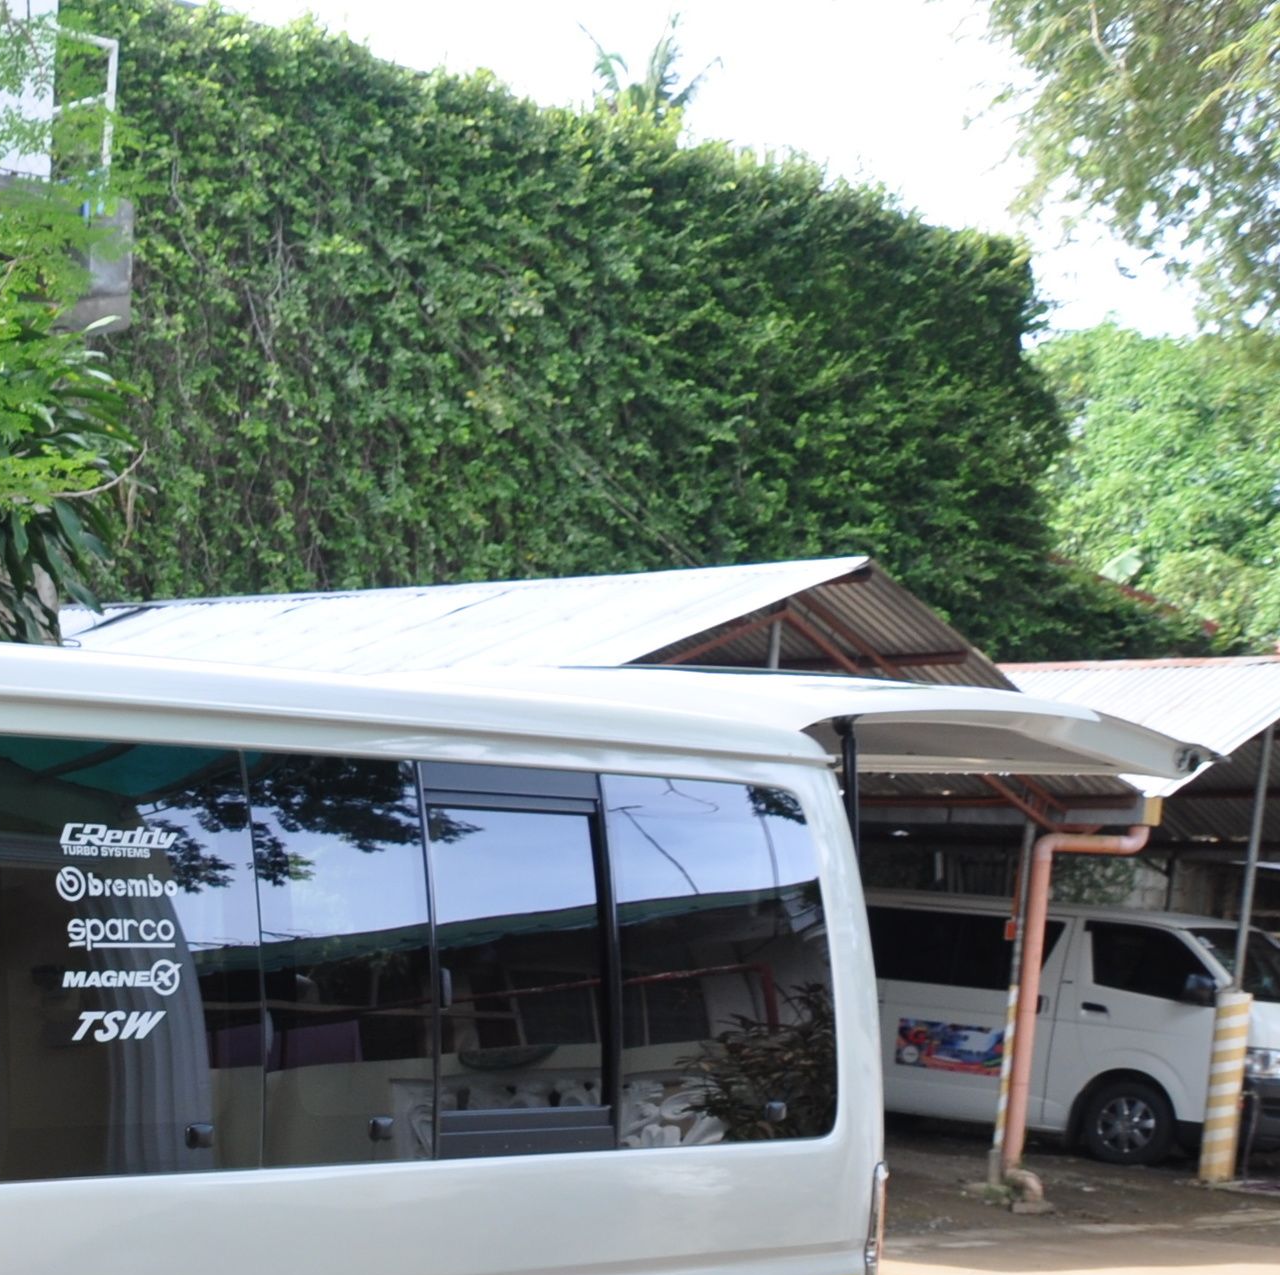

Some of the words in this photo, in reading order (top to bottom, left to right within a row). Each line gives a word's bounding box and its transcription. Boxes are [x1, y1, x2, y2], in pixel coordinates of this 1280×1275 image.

[59, 822, 178, 849] GReddy
[61, 845, 99, 857] TURBO
[101, 846, 151, 858] SYSTEMS
[87, 872, 178, 897] brembo
[67, 918, 176, 951] sparco
[71, 1010, 167, 1042] TSW
